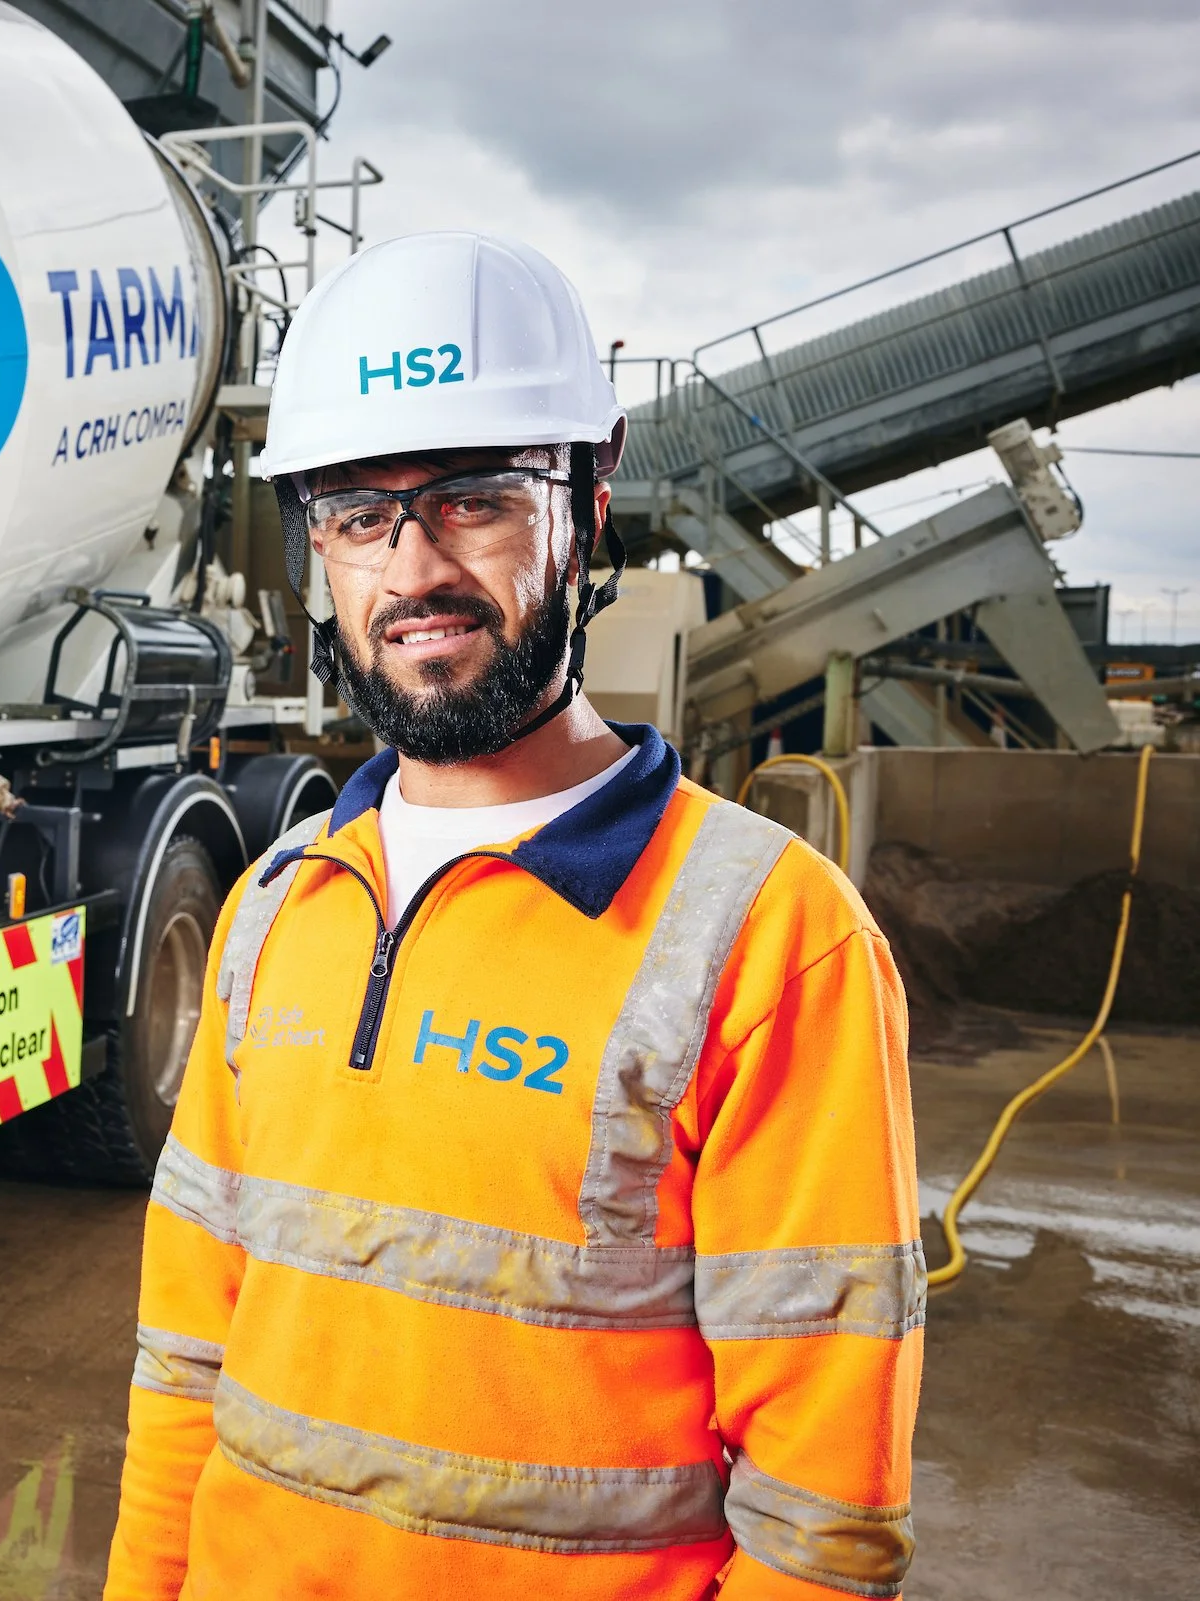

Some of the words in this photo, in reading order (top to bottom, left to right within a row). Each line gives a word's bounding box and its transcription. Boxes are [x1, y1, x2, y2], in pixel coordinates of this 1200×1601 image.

[359, 343, 464, 395] HS2
[52, 426, 69, 466] A
[75, 414, 120, 460] CRH
[0, 1027, 45, 1068] clear
[286, 1025, 325, 1047] heart
[413, 1010, 569, 1095] HS2
